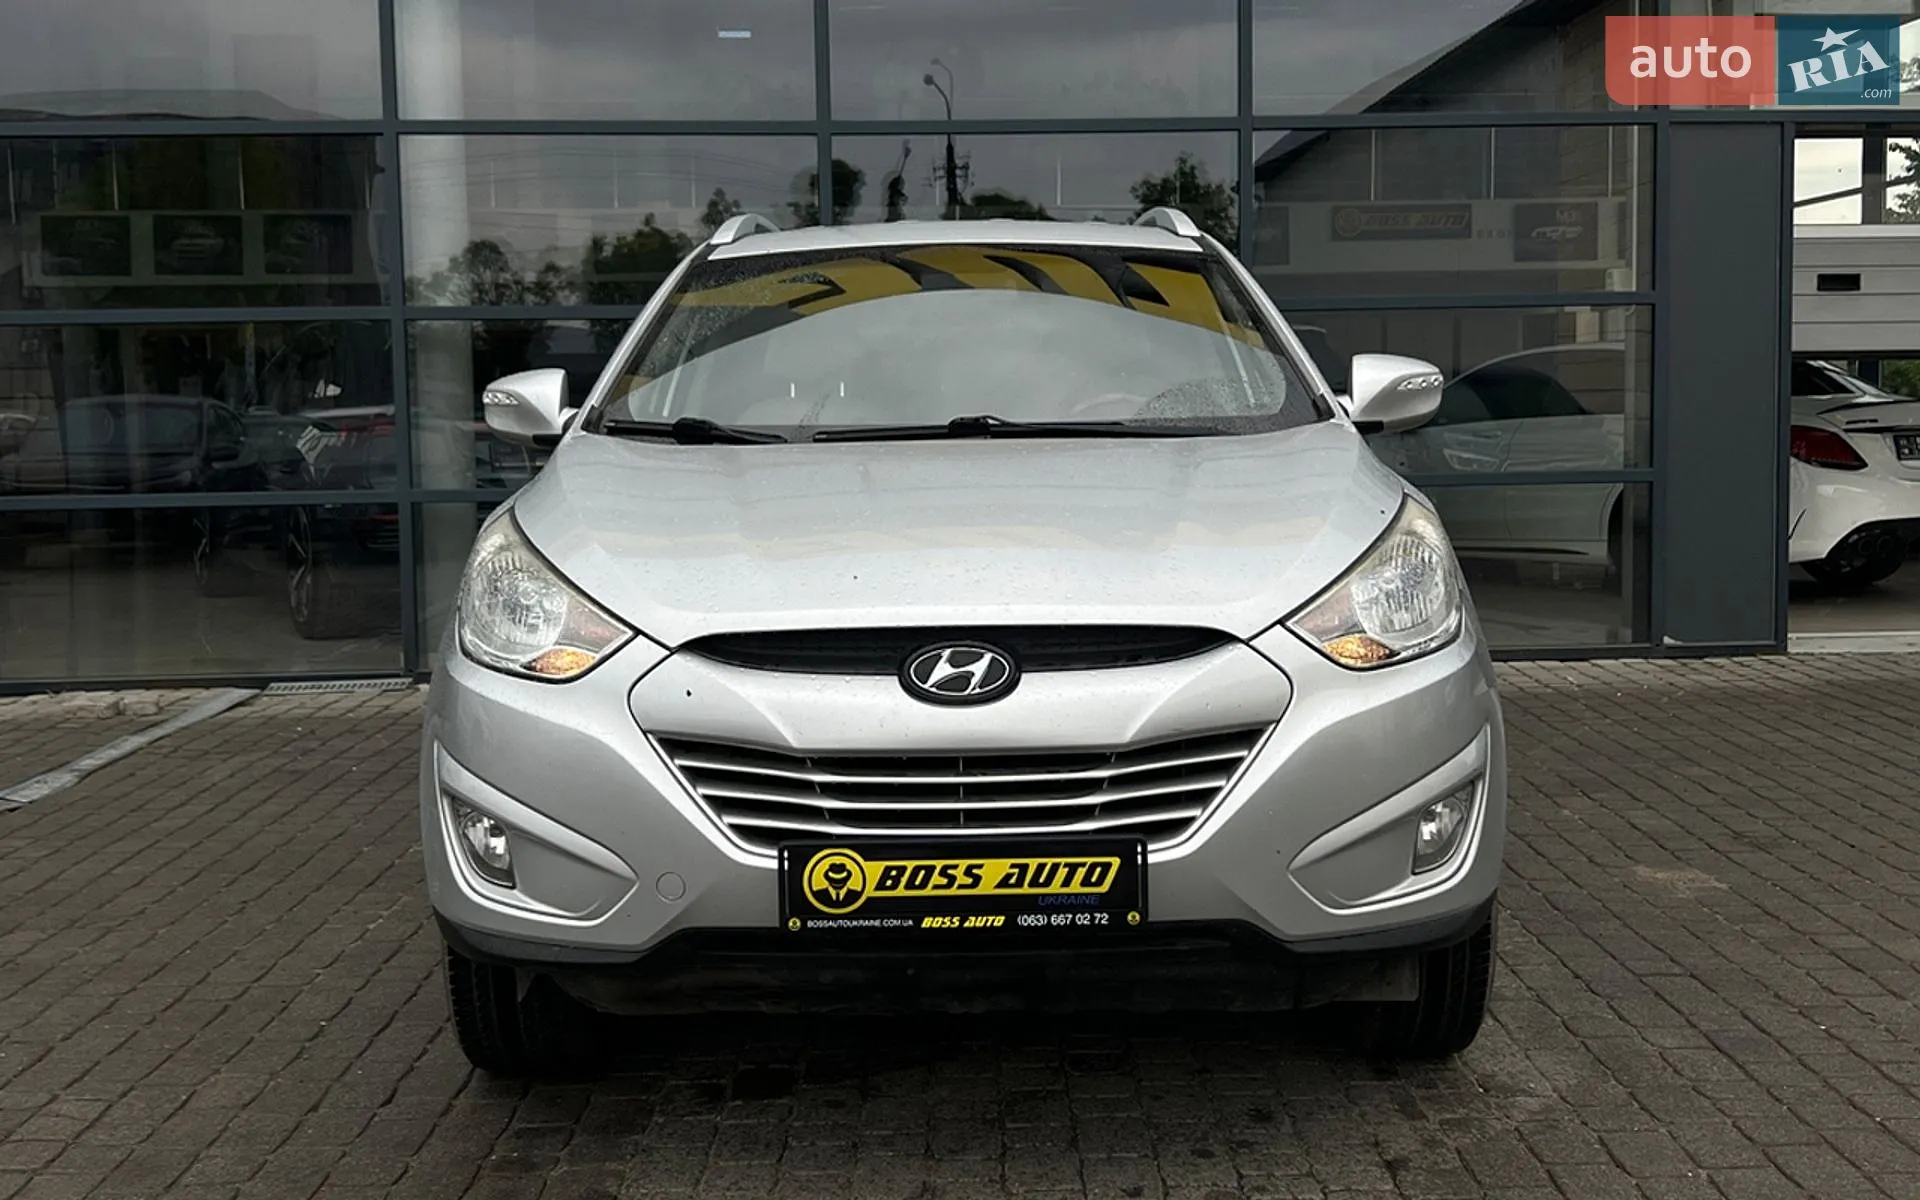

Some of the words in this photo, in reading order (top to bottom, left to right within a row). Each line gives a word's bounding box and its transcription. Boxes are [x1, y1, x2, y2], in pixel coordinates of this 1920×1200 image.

[873, 863, 986, 892] BOSS
[993, 860, 1113, 890] AUTO
[1038, 894, 1101, 906] UKRAINE
[920, 916, 961, 929] BOSS
[963, 914, 1005, 928] AUTO
[1016, 914, 1048, 927] (063)
[1050, 913, 1073, 926] 667
[1075, 913, 1091, 925] 02
[1093, 913, 1109, 925] 72
